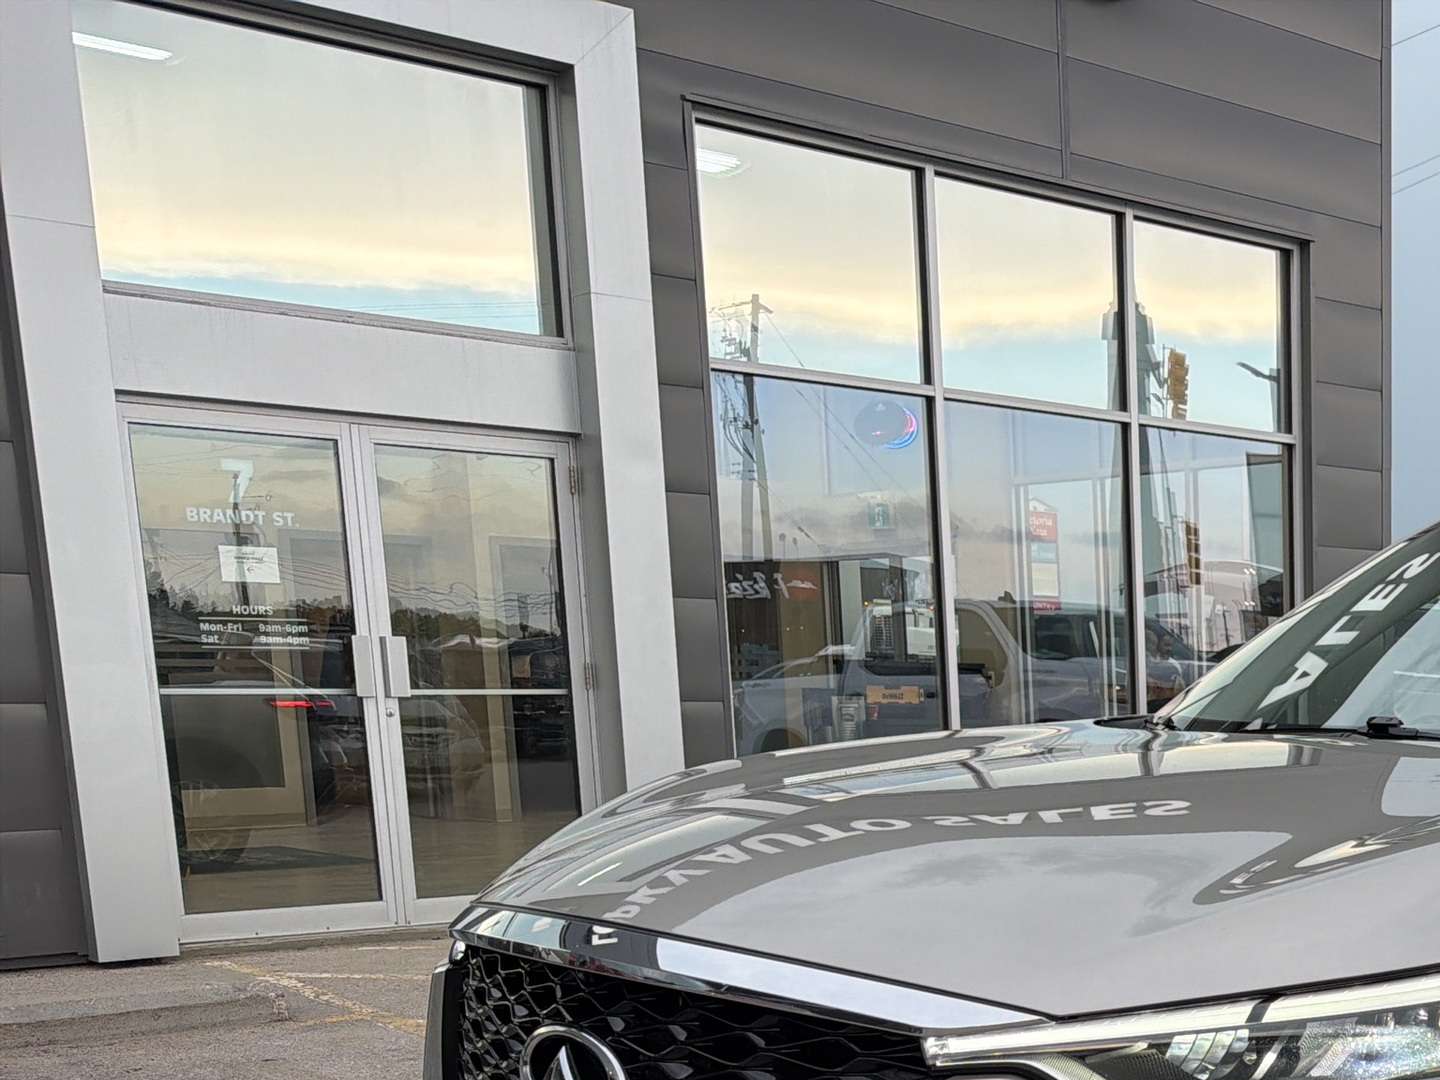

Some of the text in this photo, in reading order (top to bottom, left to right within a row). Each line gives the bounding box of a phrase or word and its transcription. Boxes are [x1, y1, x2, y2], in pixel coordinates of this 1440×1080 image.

[220, 458, 254, 503] 7
[185, 506, 300, 528] BRANDT ST.
[232, 604, 274, 616] HOURS
[200, 634, 219, 643] Sat
